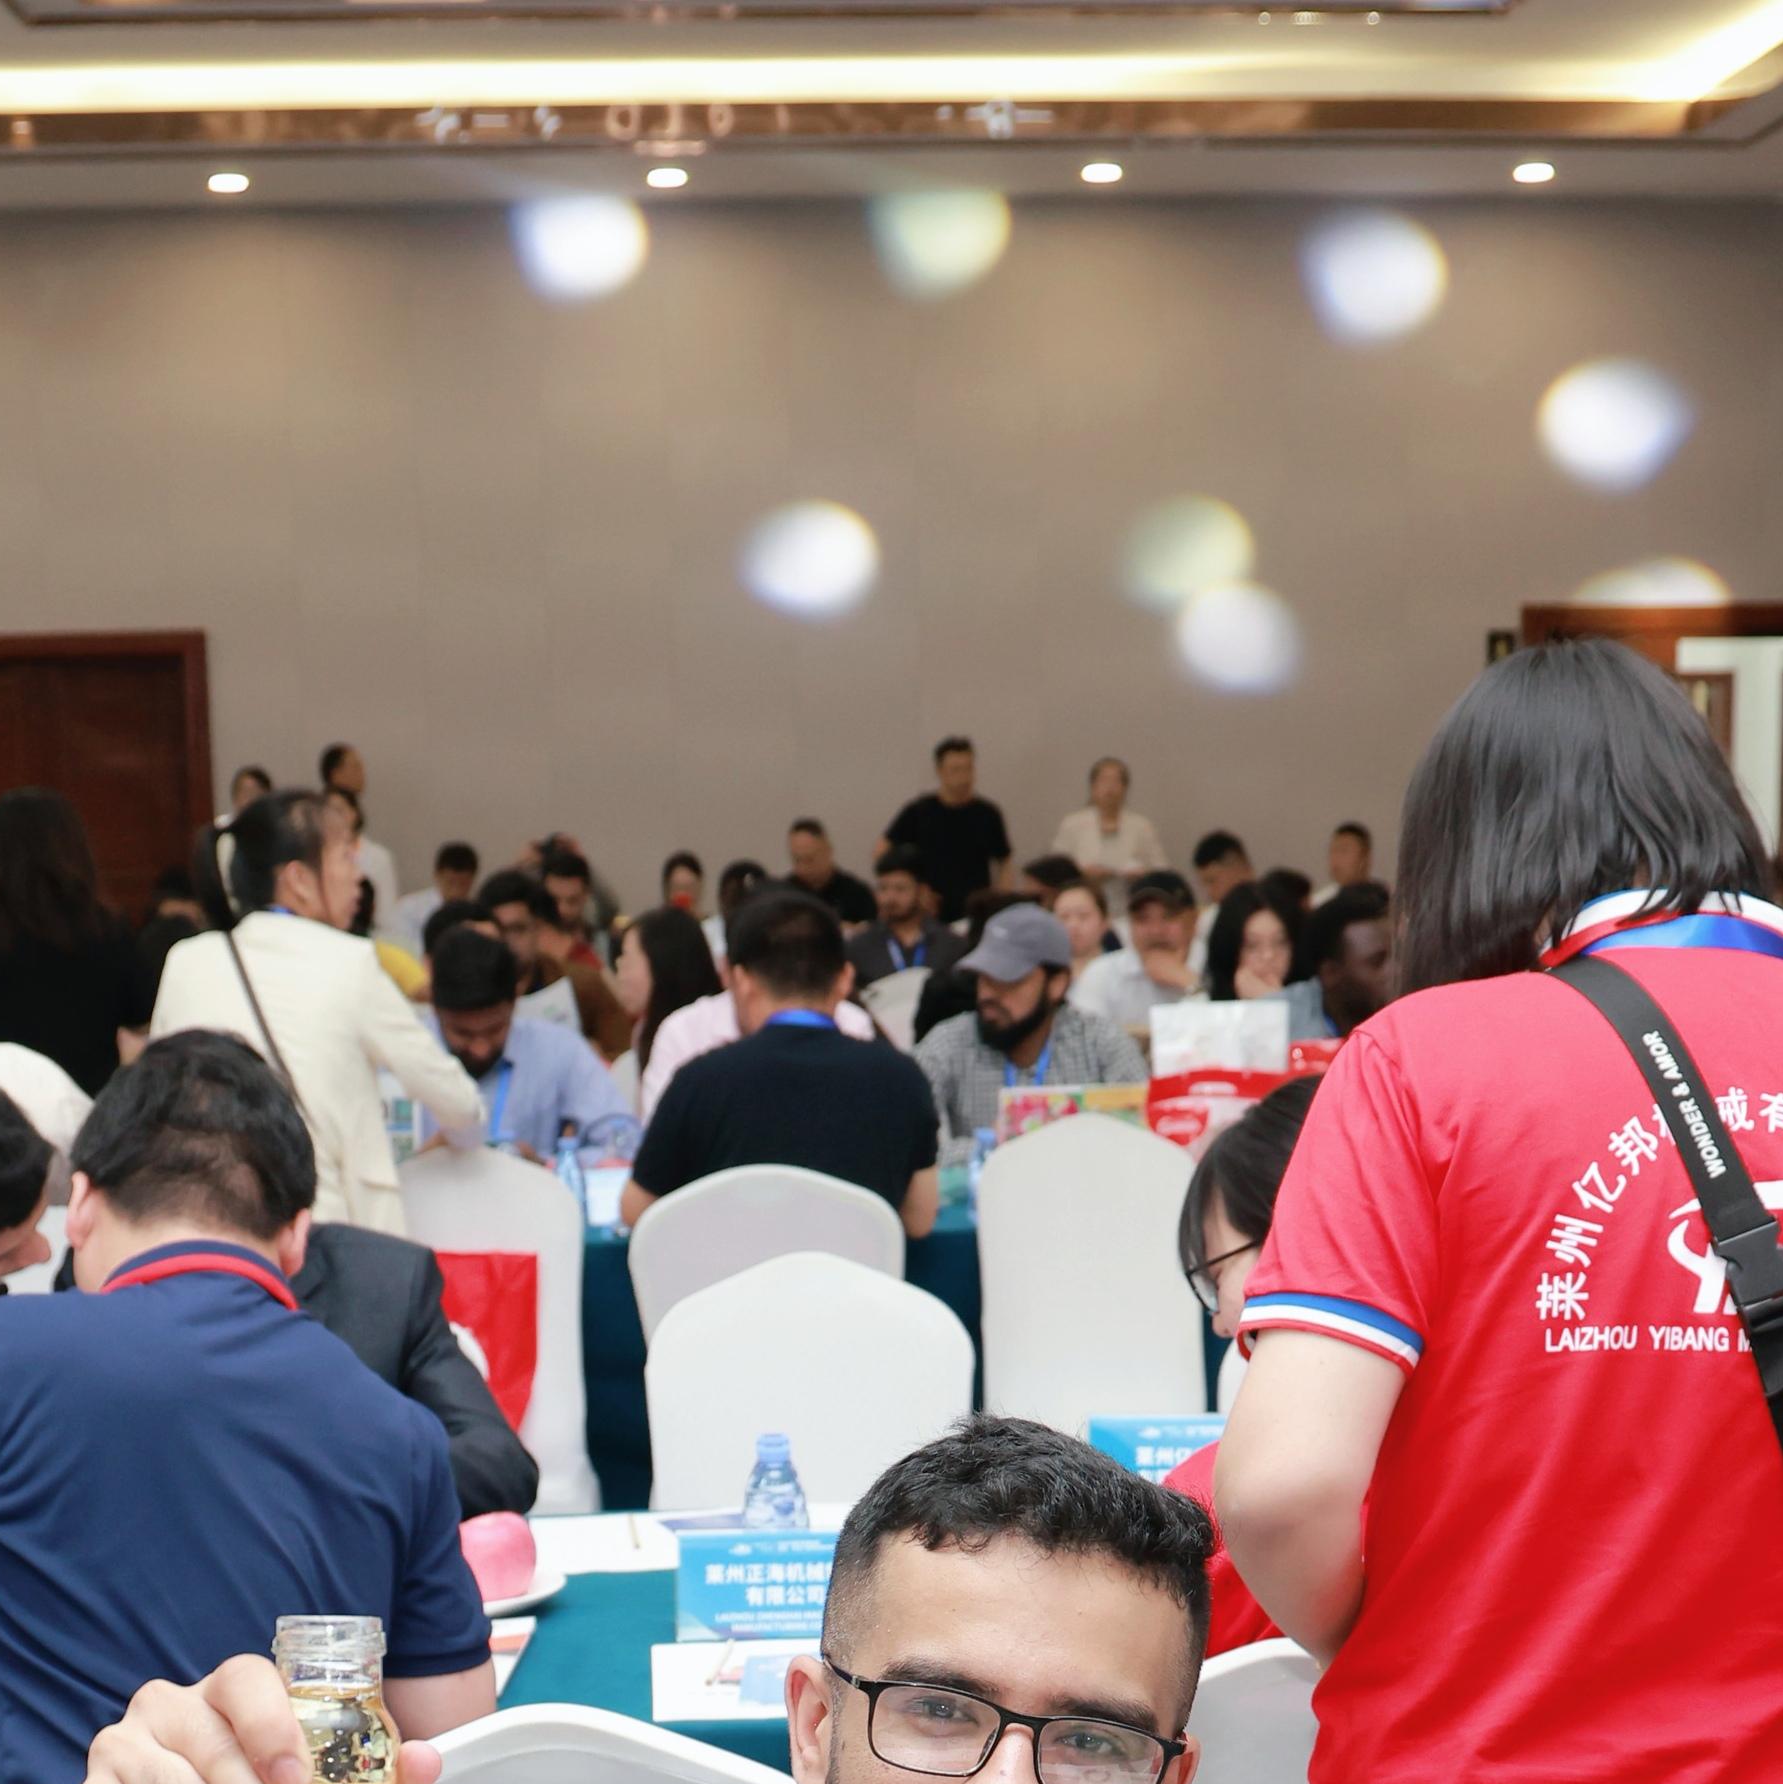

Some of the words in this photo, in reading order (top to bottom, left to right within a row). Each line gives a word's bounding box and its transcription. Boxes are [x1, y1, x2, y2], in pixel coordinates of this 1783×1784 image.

[1642, 1030, 1683, 1080] AMOR
[1672, 1081, 1691, 1098] &
[1678, 1098, 1726, 1179] WONDER
[1544, 1326, 1638, 1354] LAIZHOU
[1649, 1326, 1730, 1354] YIBANG
